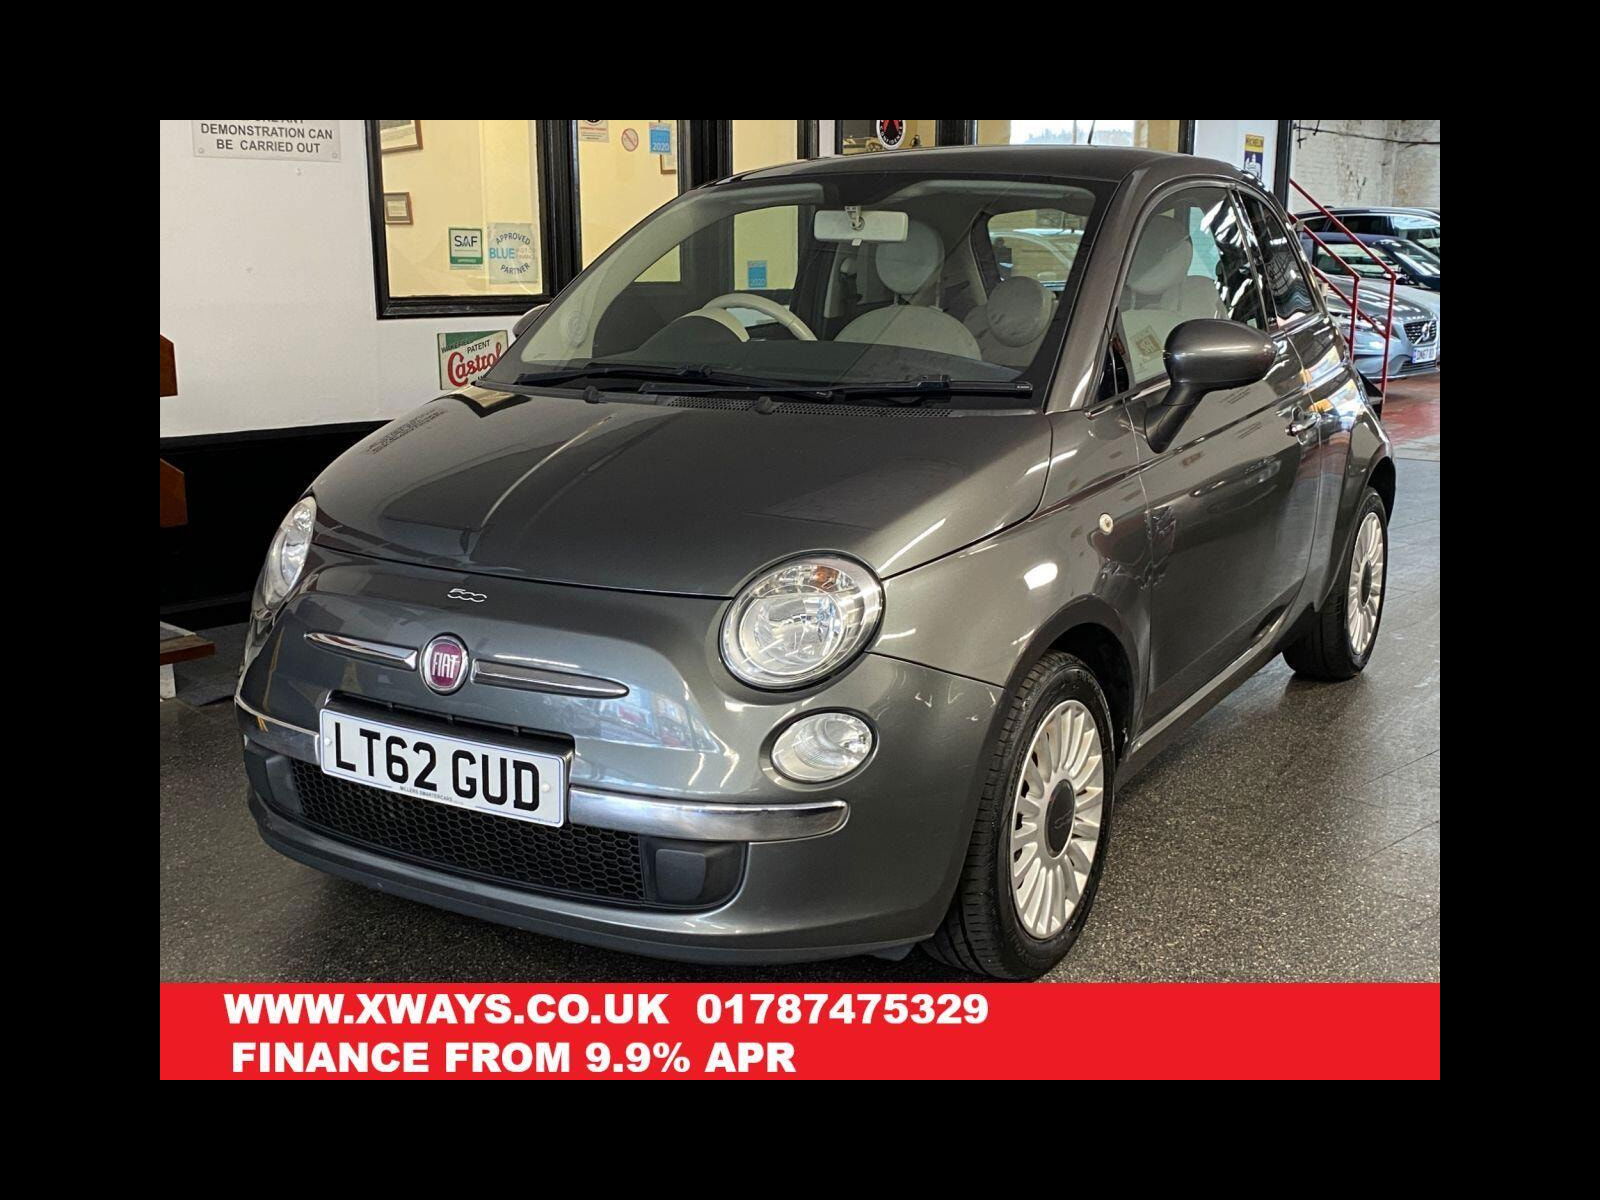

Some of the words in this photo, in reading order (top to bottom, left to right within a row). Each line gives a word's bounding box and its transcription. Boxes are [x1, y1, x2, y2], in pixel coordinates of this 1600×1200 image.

[201, 123, 305, 138] DEMONSTRATION
[308, 129, 333, 140] CAN
[216, 139, 233, 150] BE
[240, 140, 294, 152] CARRIED
[296, 143, 320, 153] OUT
[652, 142, 670, 152] 2020
[454, 235, 478, 248] SAF
[495, 232, 531, 246] APPROVED
[489, 247, 515, 260] BLUE
[500, 262, 531, 276] PARTNER
[467, 340, 491, 354] PATENT
[448, 342, 502, 387] Castrol
[448, 588, 487, 602] 500
[432, 652, 461, 678] FIAT
[335, 722, 437, 791] LT62
[452, 749, 540, 811] GUD
